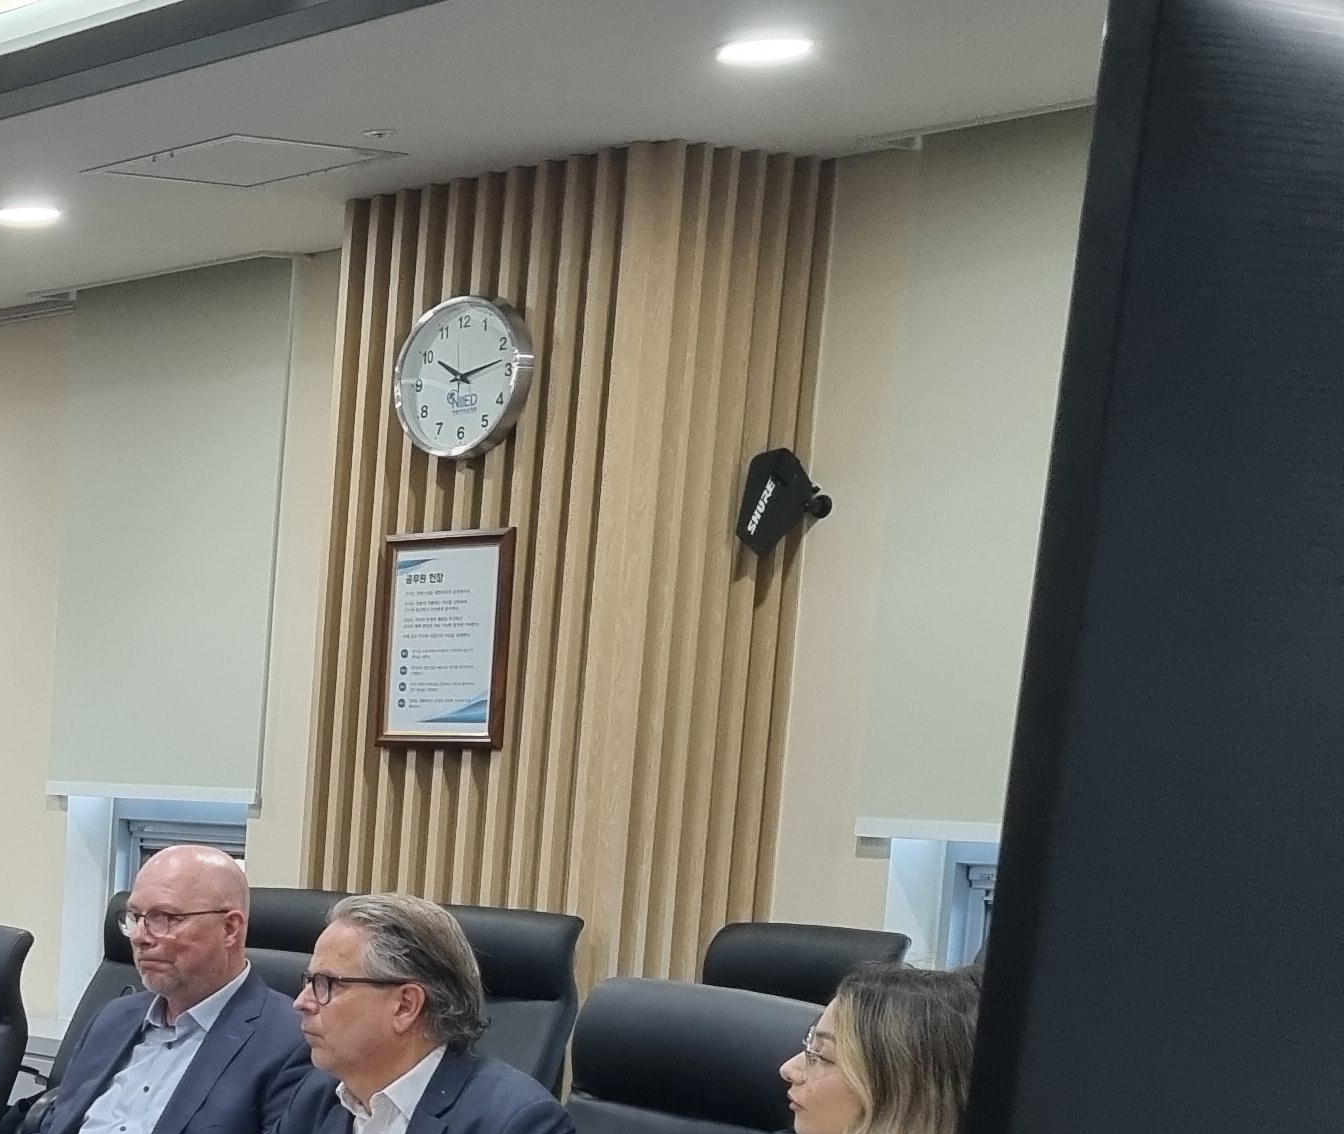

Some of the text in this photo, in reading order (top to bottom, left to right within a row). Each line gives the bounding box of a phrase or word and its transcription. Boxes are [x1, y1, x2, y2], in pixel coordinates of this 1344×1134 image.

[458, 315, 471, 329] 12
[482, 318, 488, 331] 1
[438, 326, 450, 340] 11
[499, 336, 508, 351] 2
[422, 350, 434, 364] 10
[504, 363, 512, 377] 3
[415, 379, 423, 392] 9
[495, 392, 504, 405] 4
[420, 405, 429, 418] 8
[481, 414, 489, 428] 5
[435, 422, 444, 435] 7
[456, 426, 465, 440] 6
[747, 476, 776, 536] SHURE
